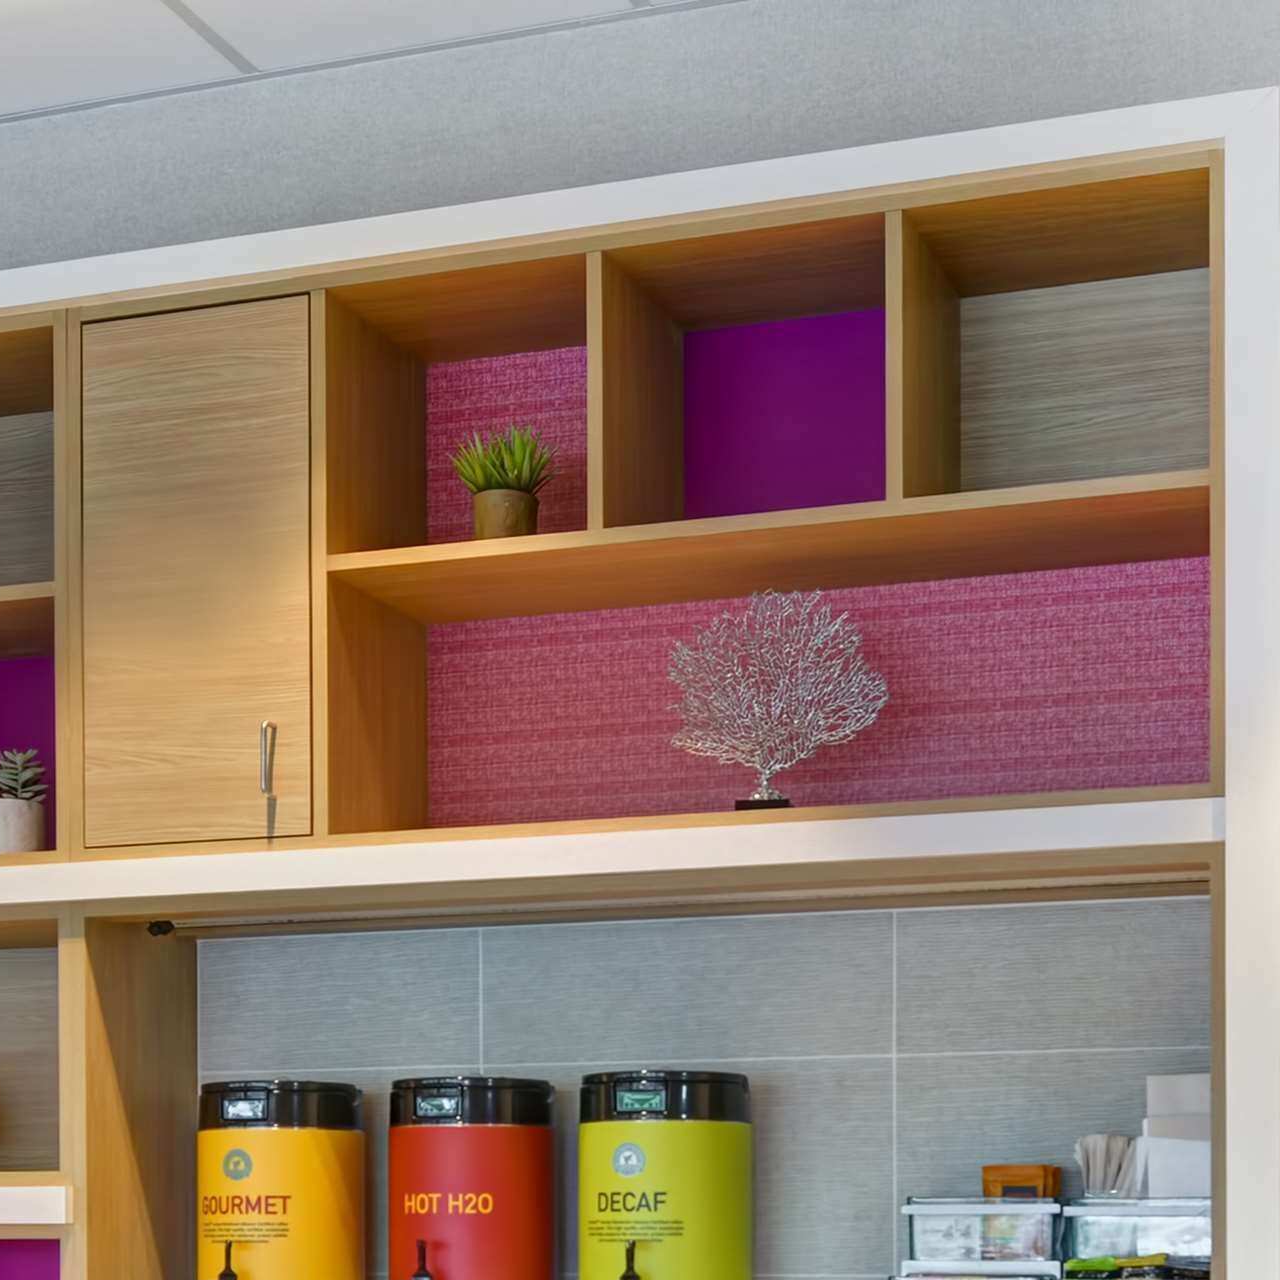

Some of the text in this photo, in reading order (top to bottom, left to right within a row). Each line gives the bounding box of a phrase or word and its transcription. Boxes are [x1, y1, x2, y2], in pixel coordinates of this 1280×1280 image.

[202, 1195, 292, 1215] GOURMET
[404, 1193, 493, 1214] HOT H2O
[597, 1192, 667, 1212] DECAF
